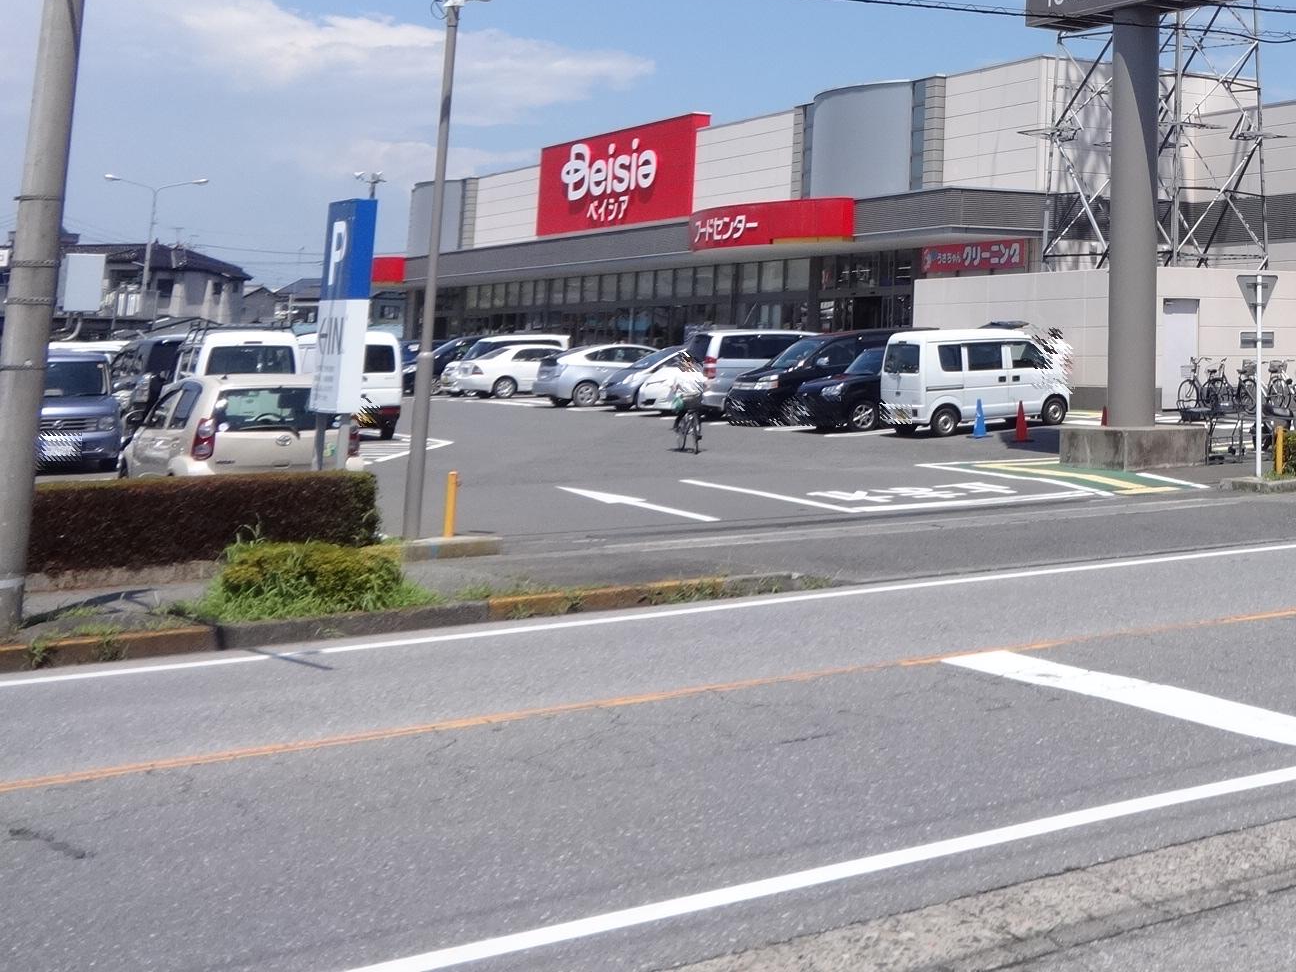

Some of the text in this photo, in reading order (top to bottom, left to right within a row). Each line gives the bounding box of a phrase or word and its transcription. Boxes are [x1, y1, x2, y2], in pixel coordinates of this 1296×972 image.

[561, 138, 657, 201] Beisia
[586, 195, 629, 222] ベイシア
[694, 215, 759, 243] フードセンター
[328, 220, 347, 286] P
[806, 481, 1018, 503] 止まれ
